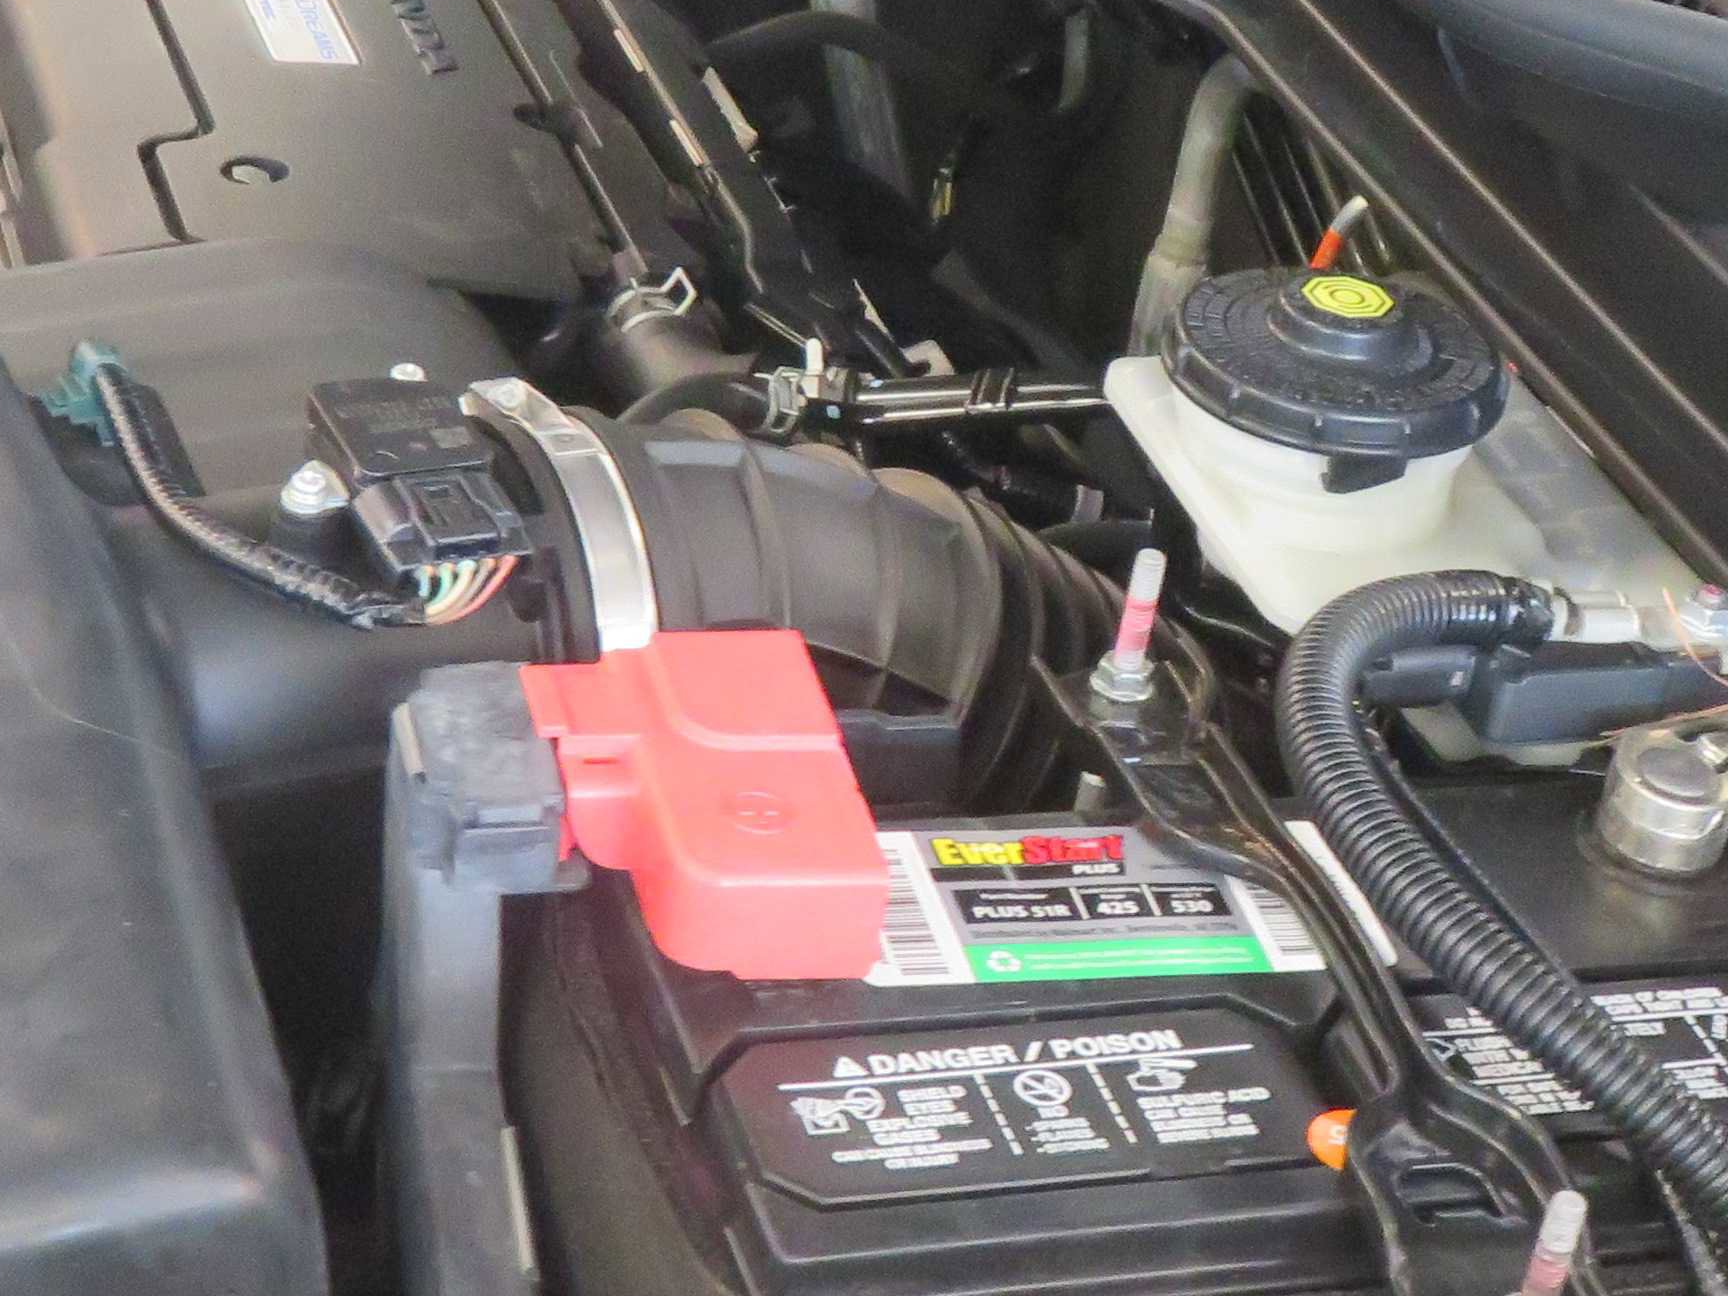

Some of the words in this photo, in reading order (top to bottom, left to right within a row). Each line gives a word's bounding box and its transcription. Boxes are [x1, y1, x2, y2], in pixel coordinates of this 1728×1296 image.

[930, 834, 1124, 866] EverStart
[1073, 862, 1121, 876] PLUS
[972, 905, 1029, 918] PLUS
[1096, 900, 1140, 915] 425
[1170, 899, 1214, 913] 530
[867, 1043, 1019, 1076] DANGER
[1048, 1029, 1183, 1059] POISON
